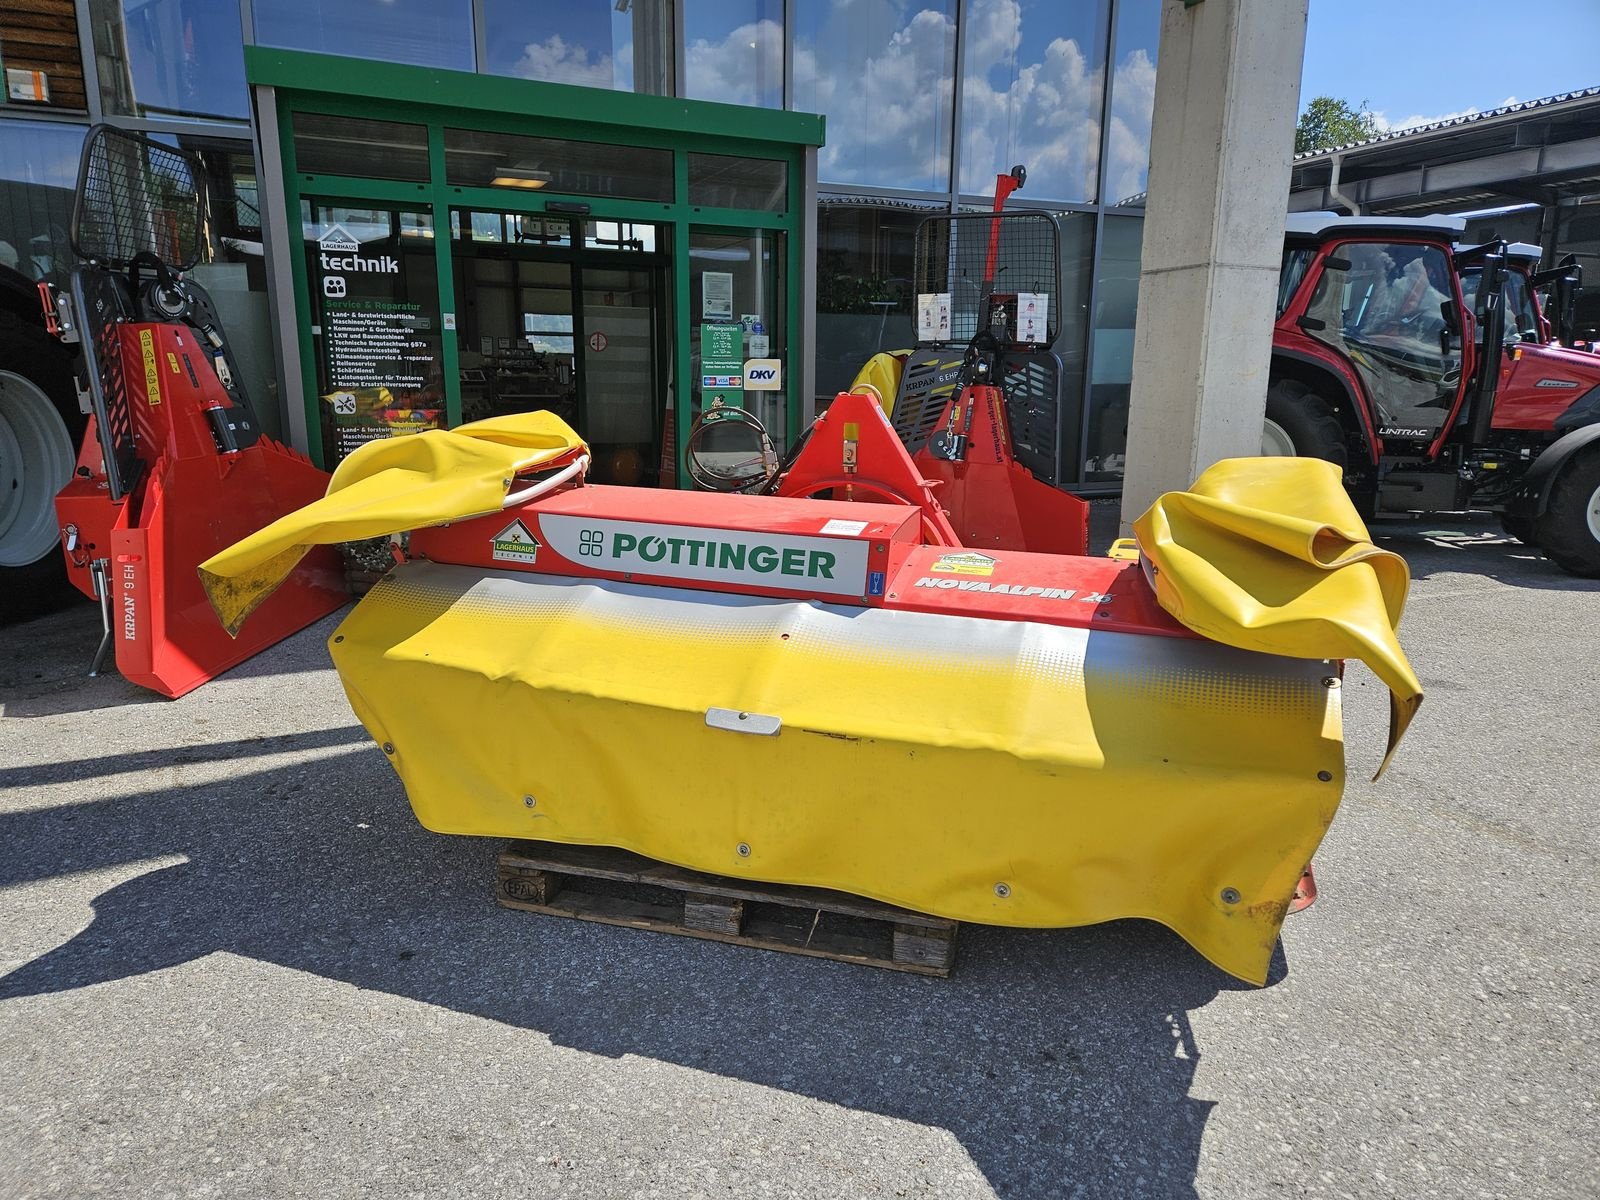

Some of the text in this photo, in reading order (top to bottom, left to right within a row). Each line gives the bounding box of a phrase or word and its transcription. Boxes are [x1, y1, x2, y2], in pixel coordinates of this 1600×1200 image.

[320, 253, 398, 273] technik
[326, 300, 361, 309] Service
[375, 301, 421, 311] Reparatur
[358, 312, 416, 320] forstwirtschaftliche
[332, 318, 386, 326] Maschinen/Geräte
[368, 340, 409, 348] Begutachtung
[335, 346, 400, 354] Hydraulikservicestelle
[749, 370, 776, 380] DKV
[906, 377, 935, 390] KRPAN
[945, 372, 959, 380] EHP
[1379, 428, 1428, 436] LINTRAC
[496, 543, 534, 553] LAGERHAUS
[612, 533, 836, 579] PÖTTINGER
[124, 564, 134, 580] EH
[914, 577, 1077, 600] NOVAALPIN
[125, 596, 136, 641] KRPAN
